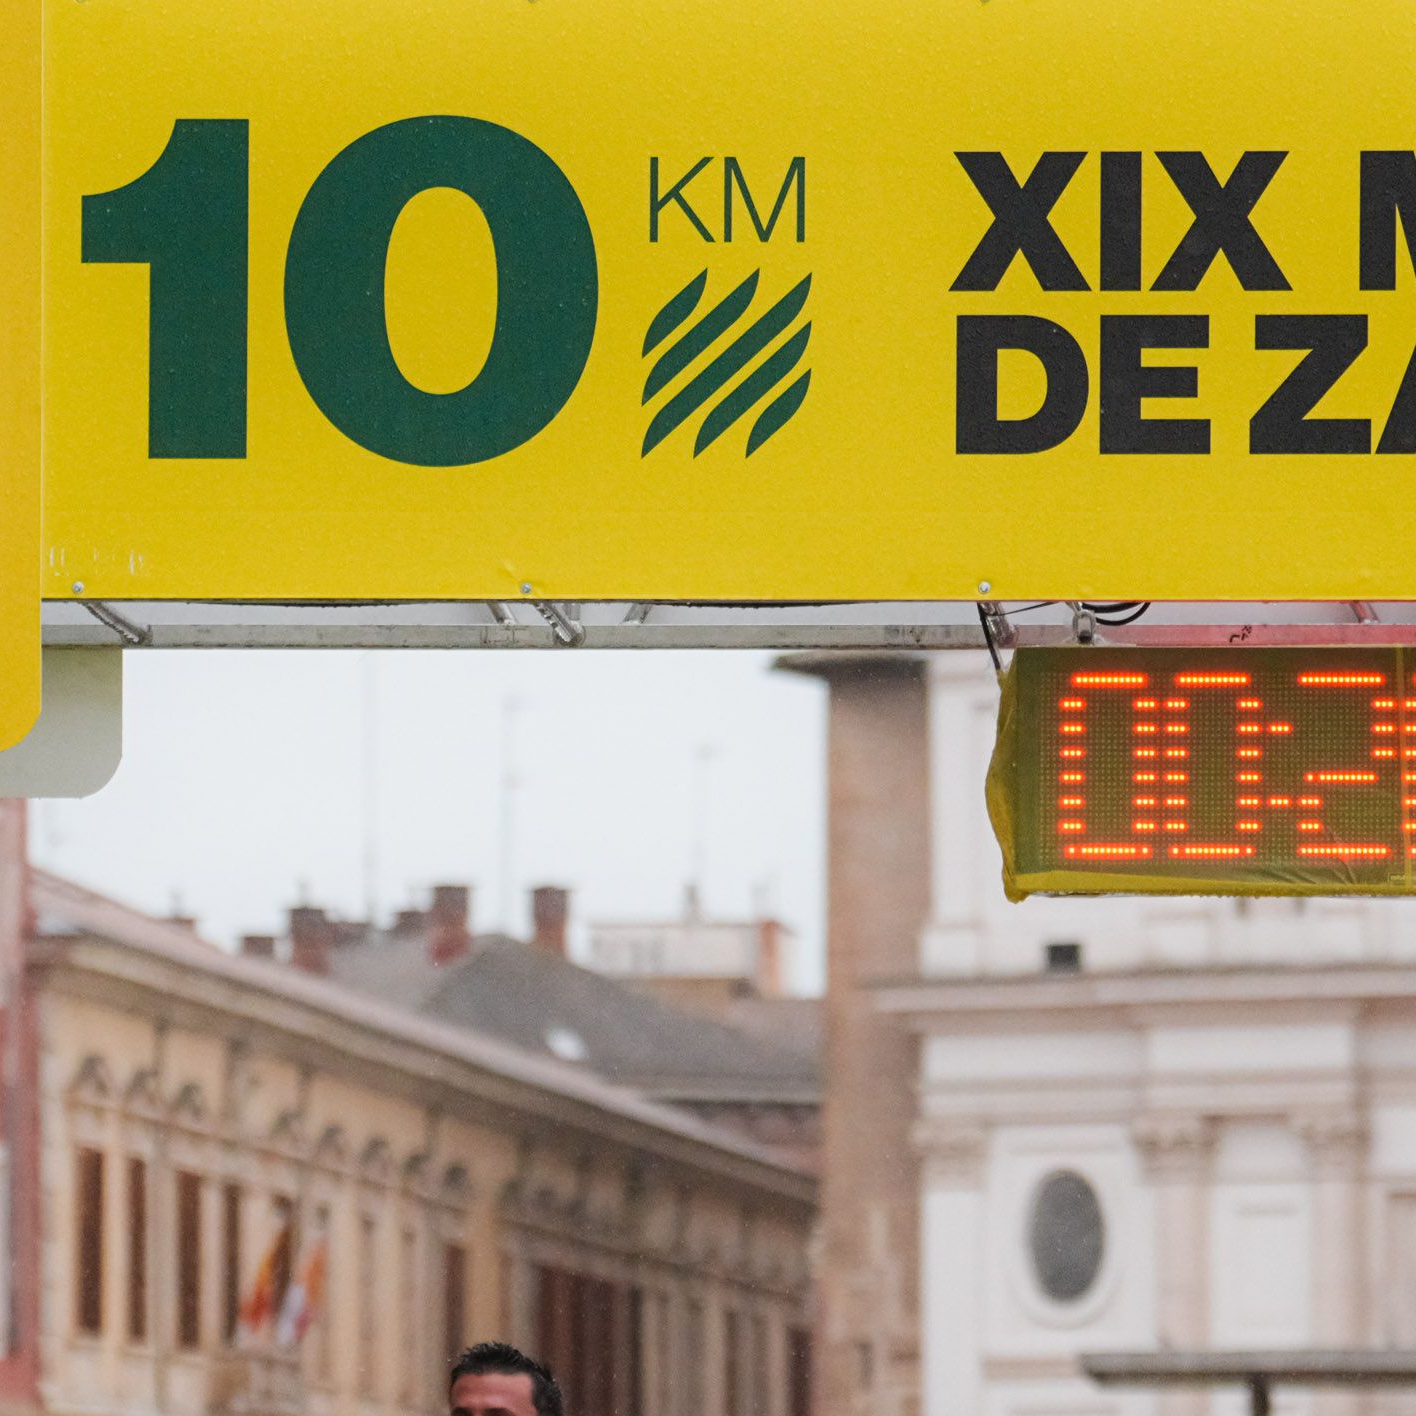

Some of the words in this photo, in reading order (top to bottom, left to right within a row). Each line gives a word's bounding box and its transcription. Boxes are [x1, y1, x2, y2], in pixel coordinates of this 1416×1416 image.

[81, 115, 599, 467] 10
[649, 156, 806, 243] KM
[948, 150, 1292, 292] XIX
[955, 312, 1211, 455] DE
